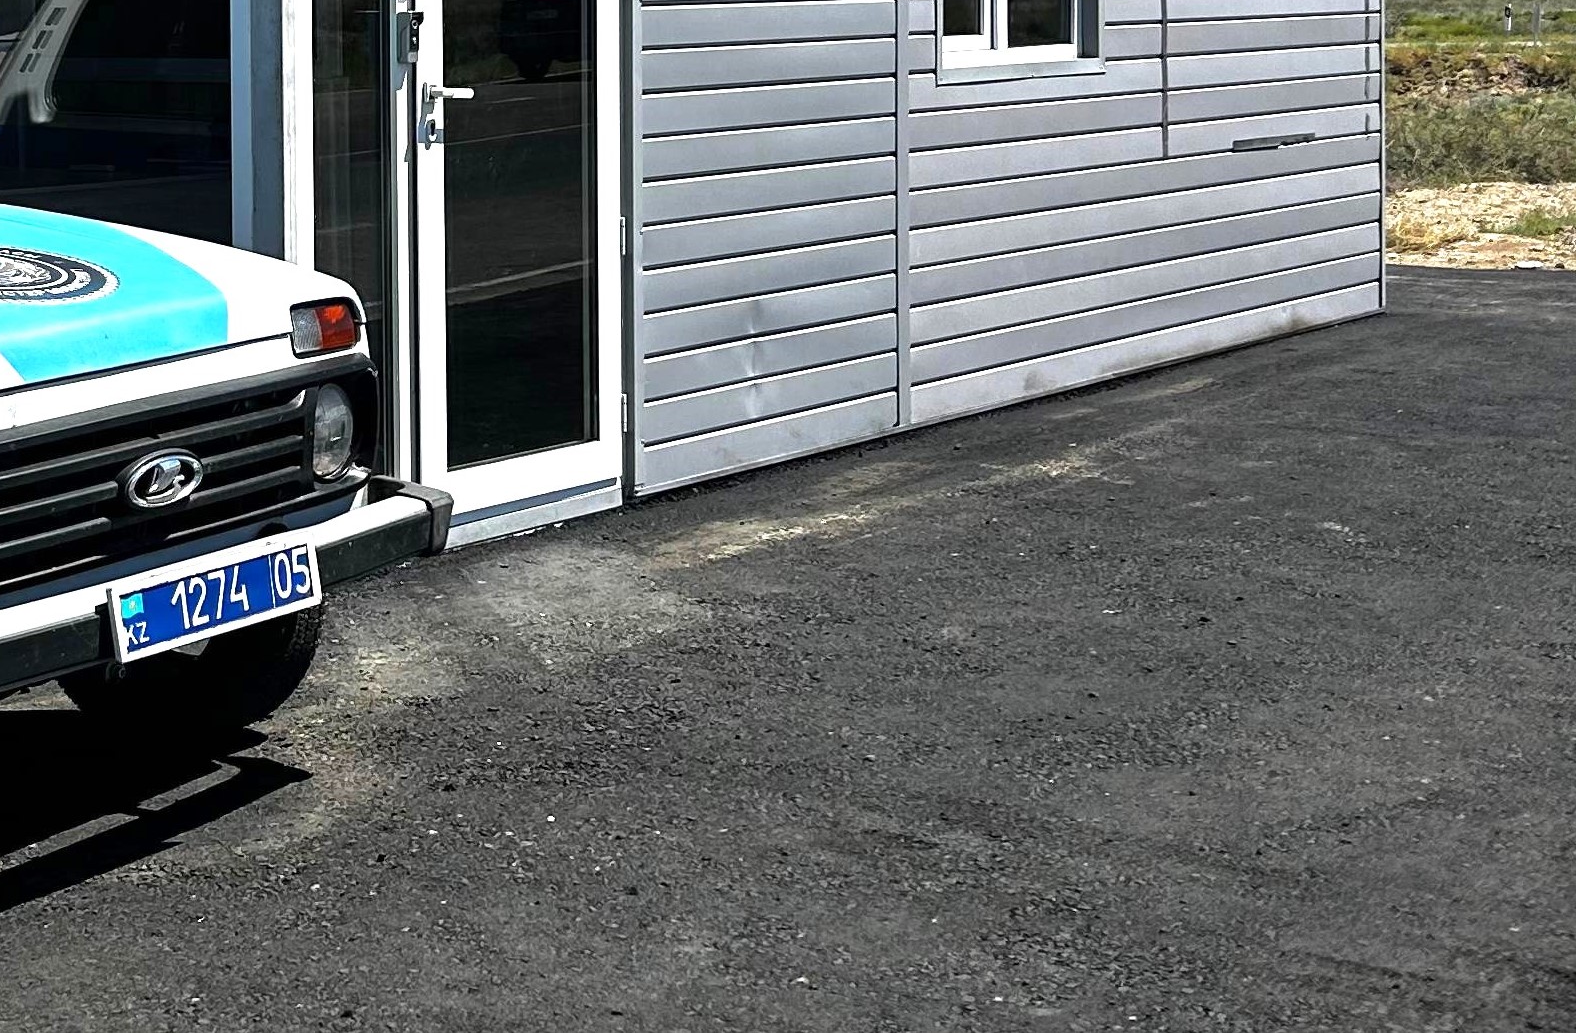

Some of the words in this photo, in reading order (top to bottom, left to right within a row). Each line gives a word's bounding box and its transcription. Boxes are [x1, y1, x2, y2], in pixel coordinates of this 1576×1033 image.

[171, 565, 250, 630] 1274
[274, 545, 311, 599] 05
[125, 621, 150, 645] KZ
